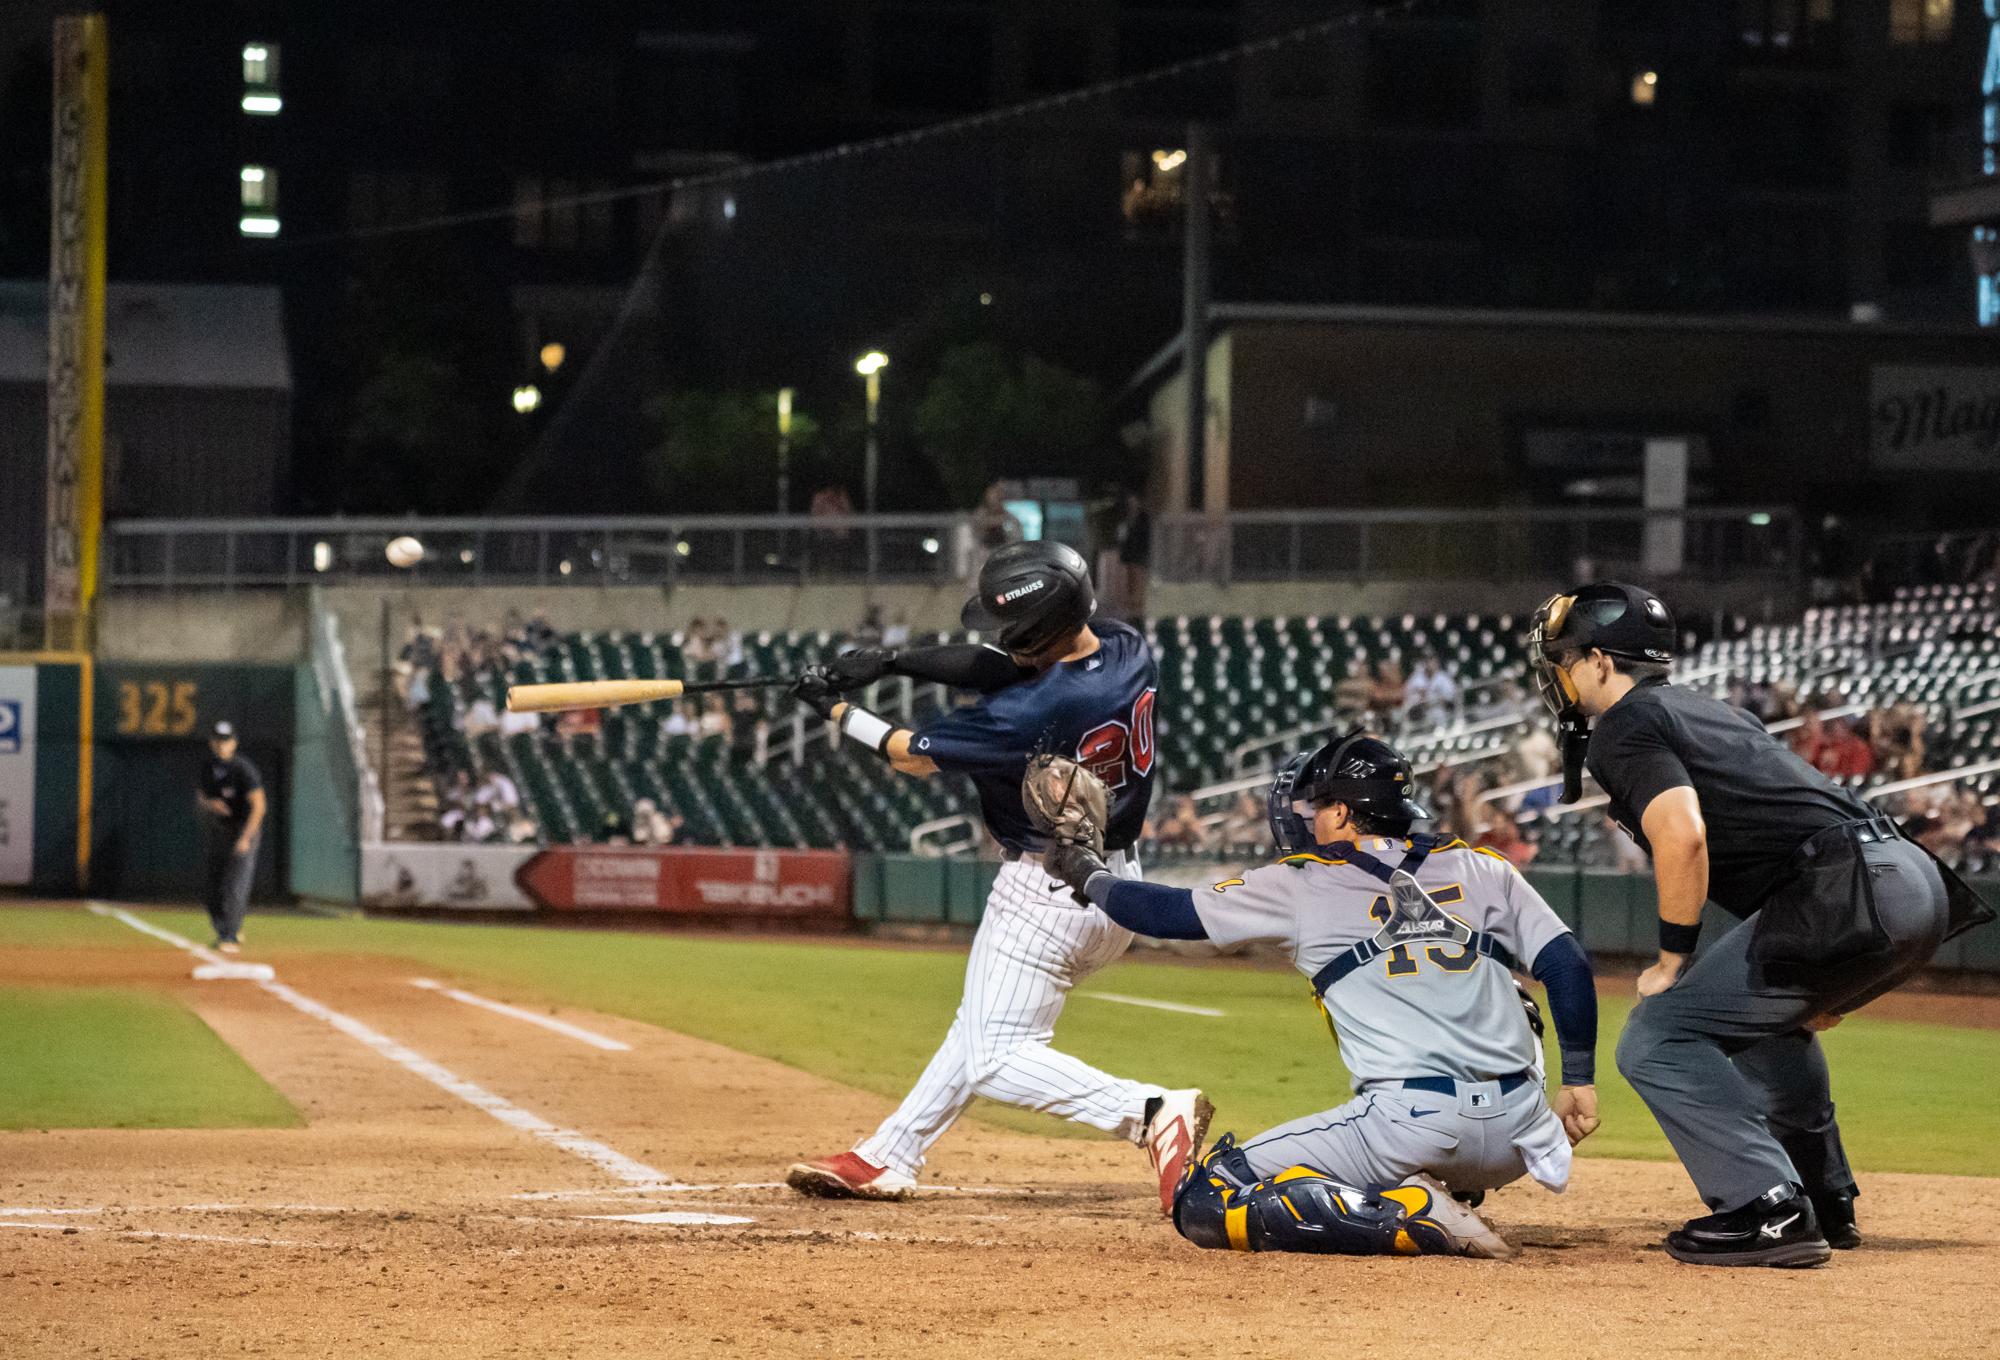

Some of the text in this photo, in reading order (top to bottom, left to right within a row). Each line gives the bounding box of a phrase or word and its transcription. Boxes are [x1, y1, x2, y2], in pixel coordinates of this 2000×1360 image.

[1005, 579, 1044, 601] STRAUSS
[119, 682, 196, 734] 325
[1075, 686, 1157, 790] 20
